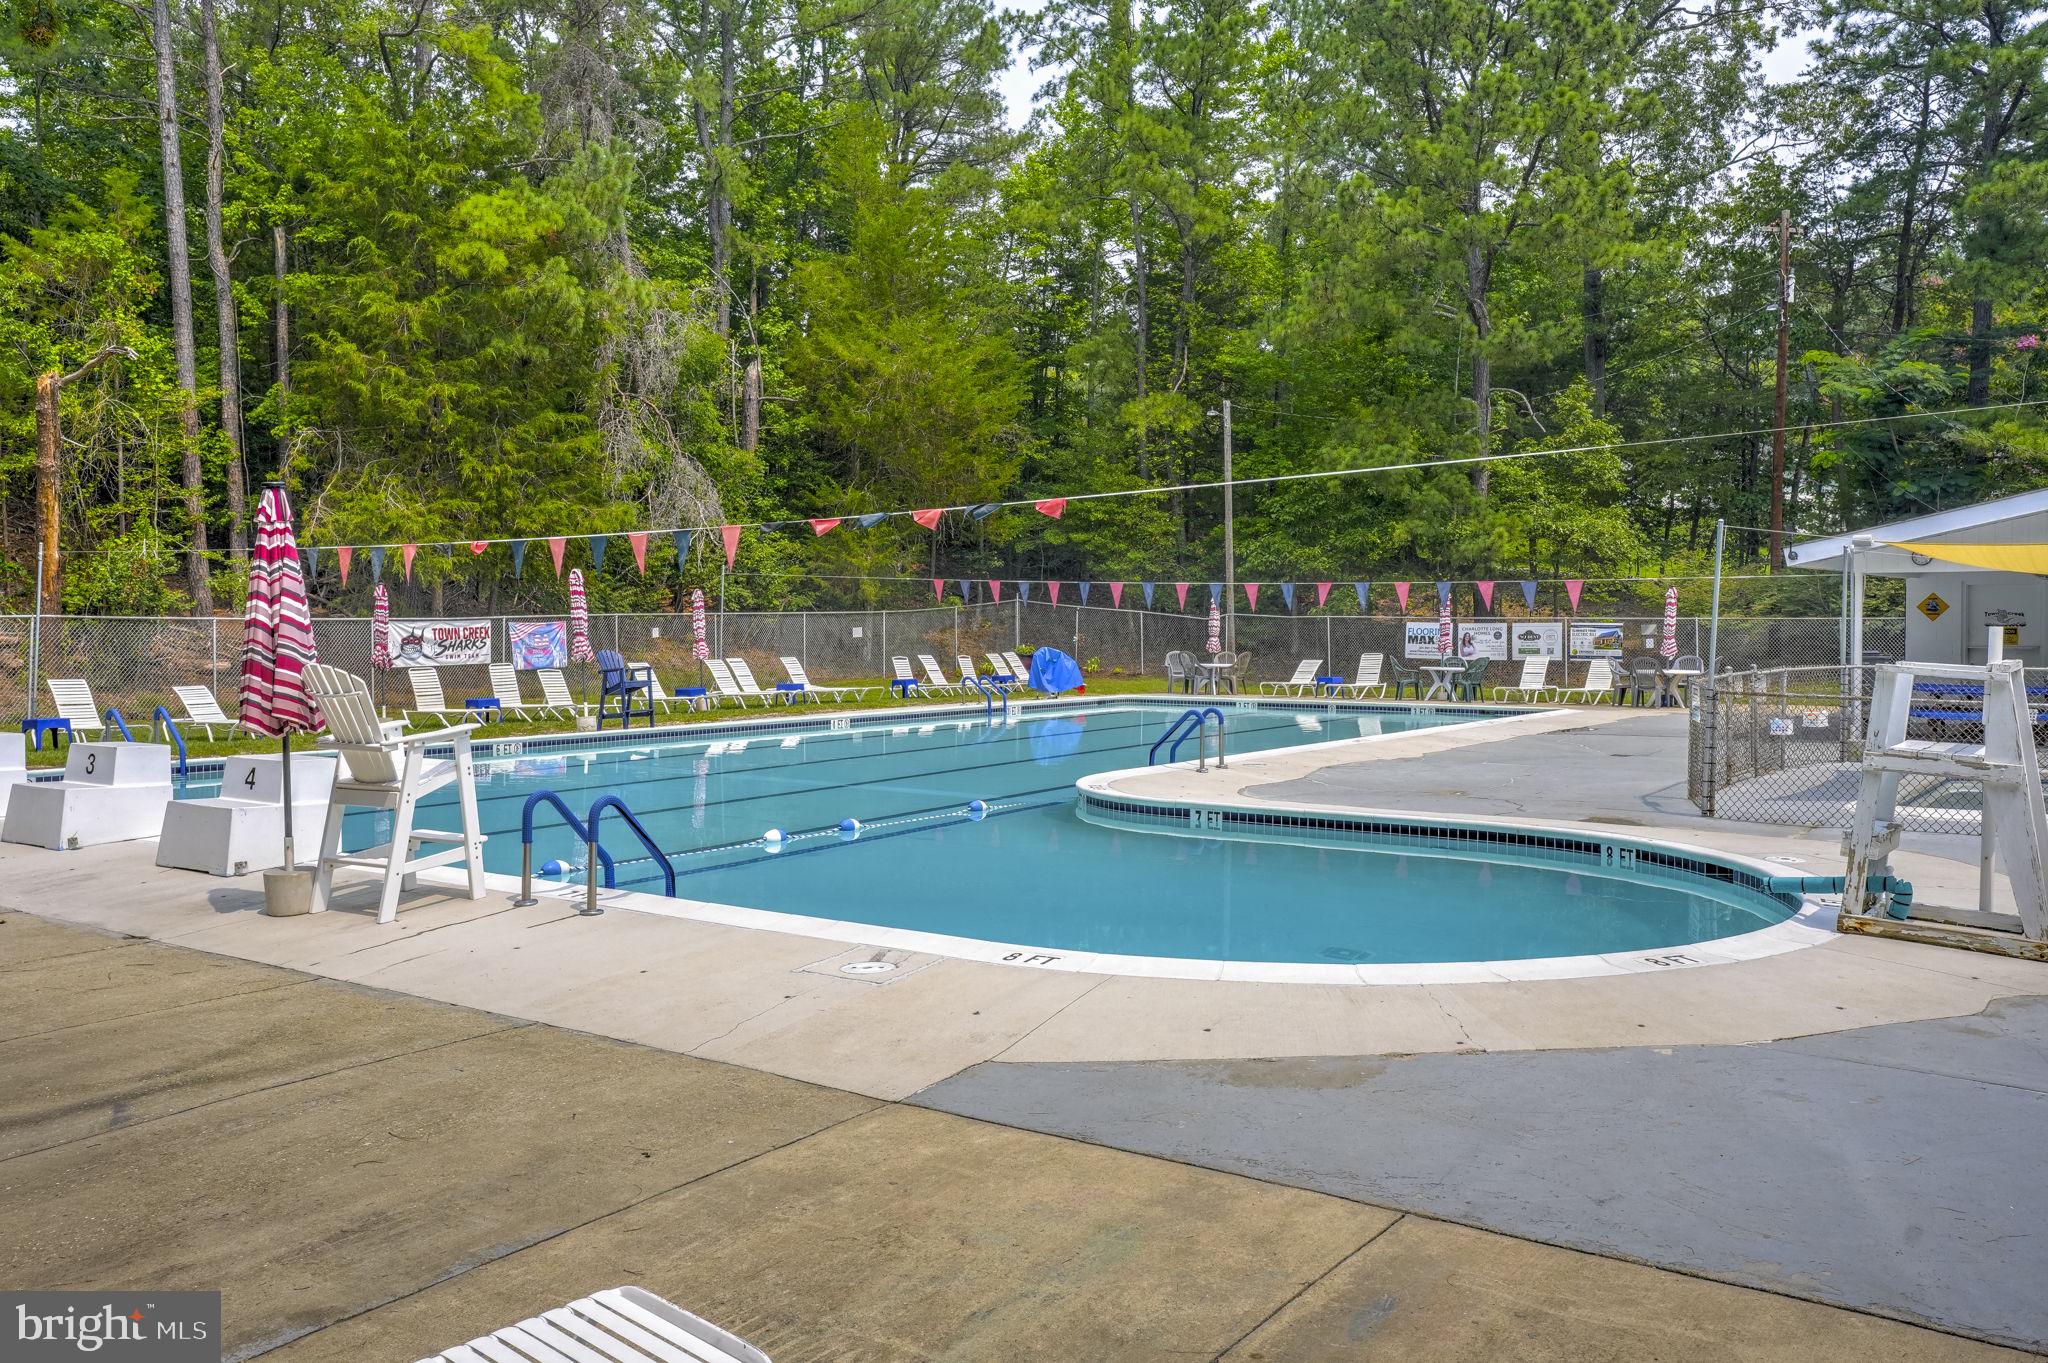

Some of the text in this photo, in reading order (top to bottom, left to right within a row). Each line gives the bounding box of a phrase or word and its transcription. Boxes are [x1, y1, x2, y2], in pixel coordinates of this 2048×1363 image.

[431, 626, 491, 641] TOWN CREEK
[1407, 627, 1441, 636] FLOORI
[1407, 635, 1435, 644] MAX
[434, 637, 487, 657] SHARKS
[86, 753, 96, 775] 3
[245, 767, 256, 790] 4
[1195, 810, 1221, 822] 7 FT
[1619, 847, 1634, 862] FT
[1002, 952, 1062, 965] 8 FT
[1644, 954, 1699, 966] 8 FT
